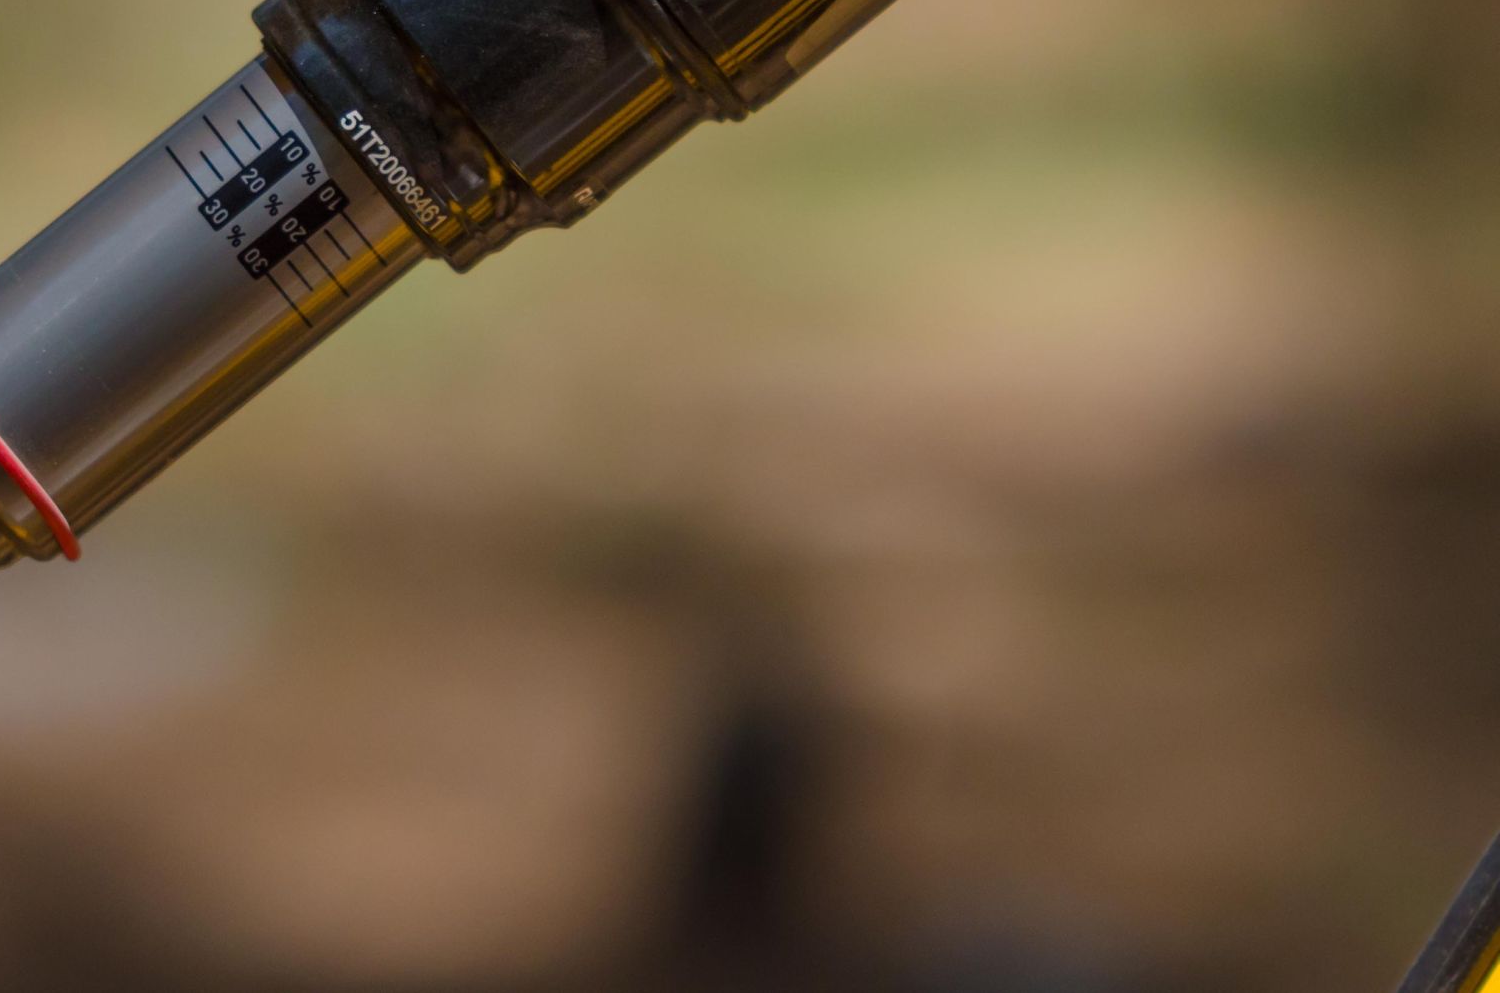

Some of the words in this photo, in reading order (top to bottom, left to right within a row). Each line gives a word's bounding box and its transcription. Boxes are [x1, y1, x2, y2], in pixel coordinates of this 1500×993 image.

[280, 137, 304, 163] 10
[241, 168, 266, 193] 20
[340, 110, 448, 231] 51T20066461
[205, 199, 229, 224] 30
